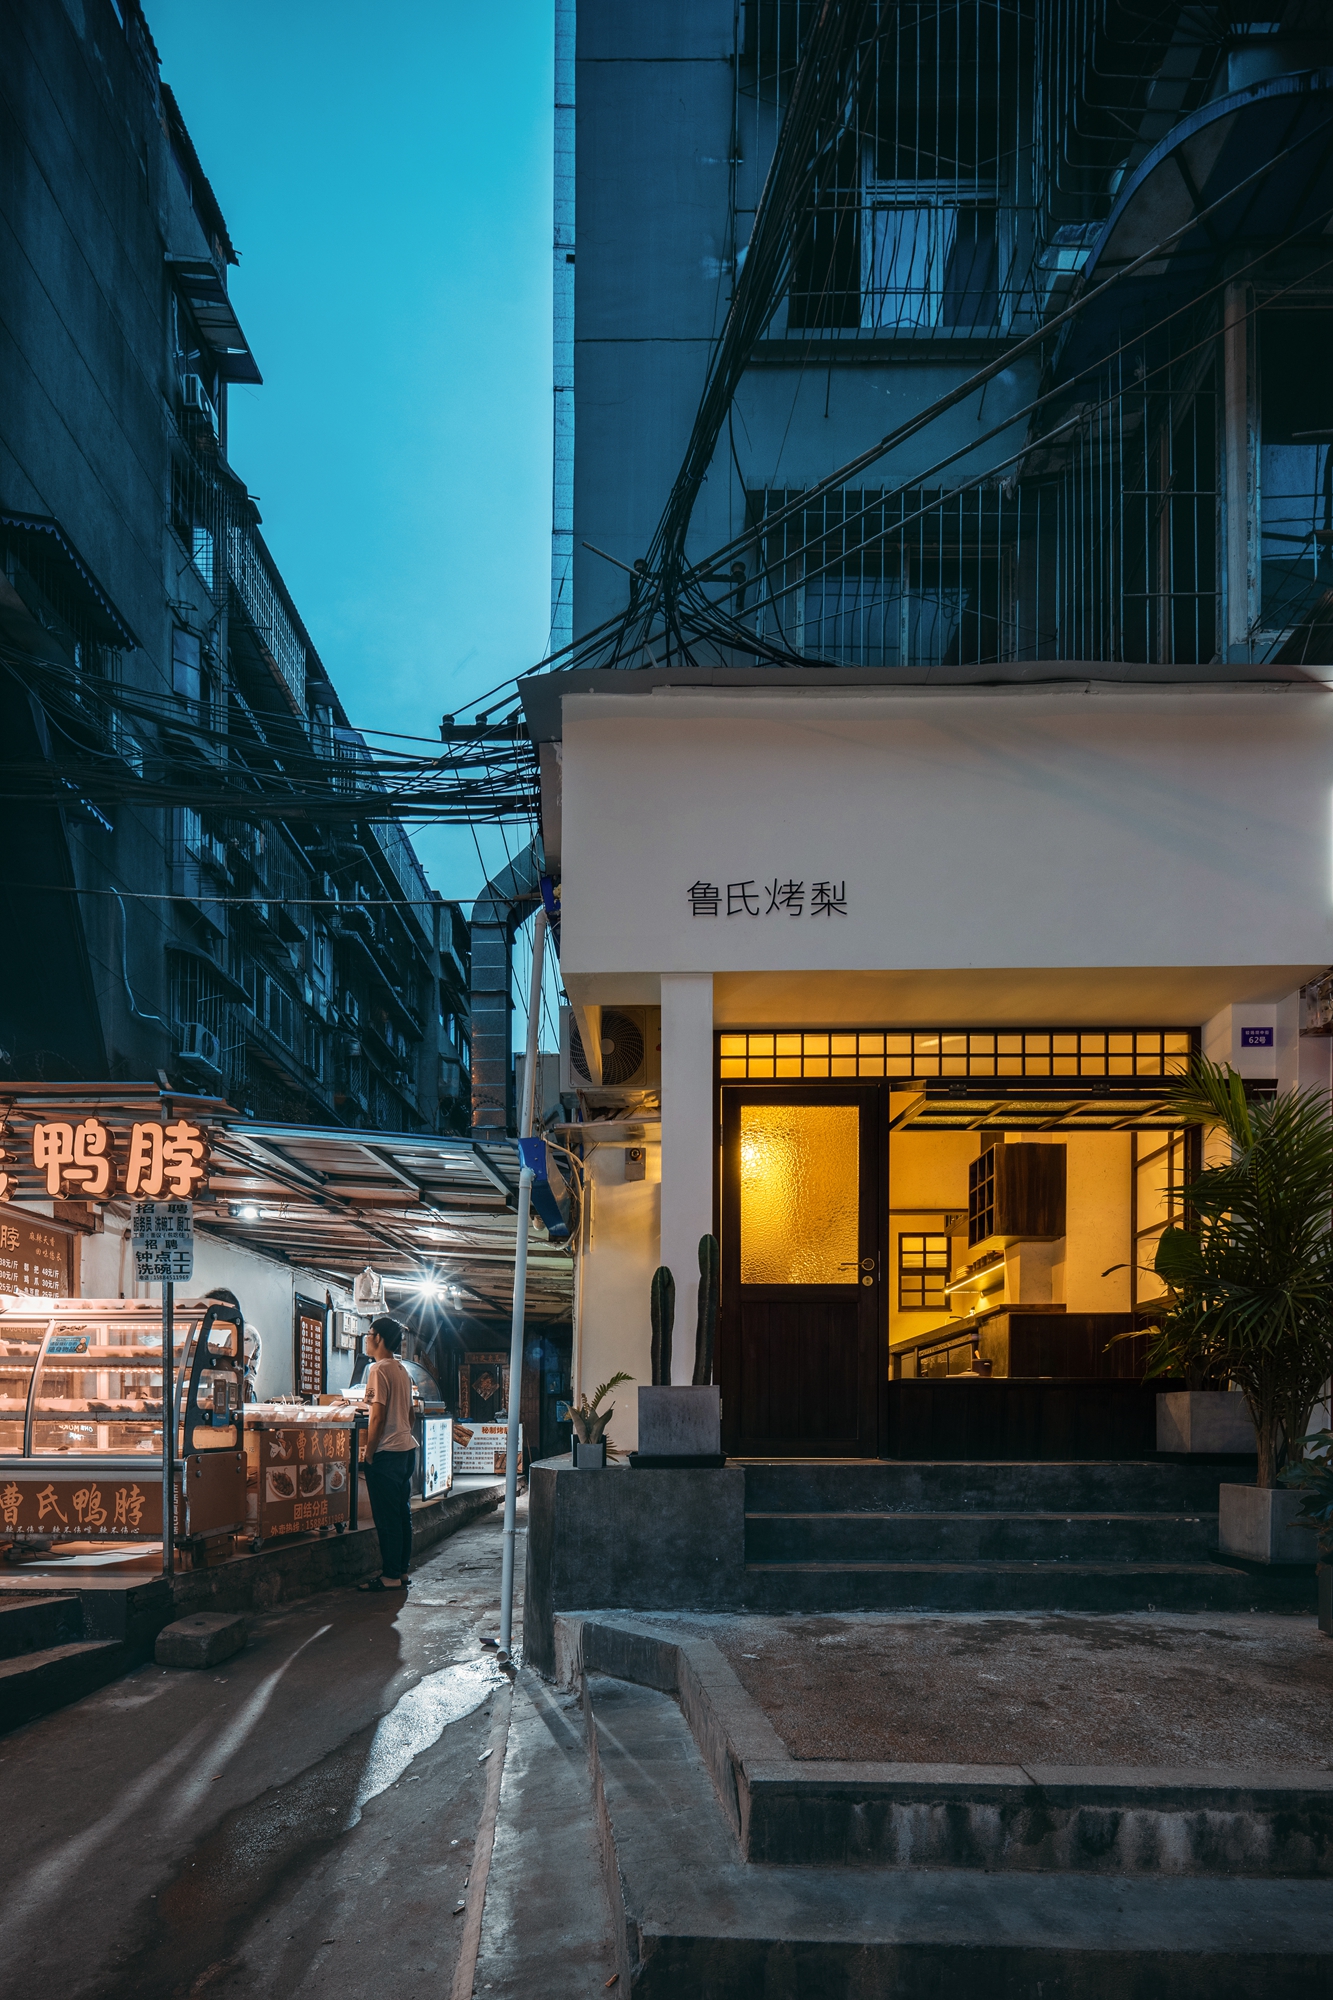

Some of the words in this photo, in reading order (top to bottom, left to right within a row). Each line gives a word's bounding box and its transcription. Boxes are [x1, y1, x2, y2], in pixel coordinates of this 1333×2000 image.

[687, 878, 848, 917] 鲁氏烤梨
[1248, 1036, 1266, 1044] 62号
[0, 1118, 204, 1196] 鸭脖
[133, 1216, 152, 1232] 服务员
[155, 1216, 174, 1232] 洗碗工
[144, 1239, 178, 1250] 招聘
[135, 1251, 191, 1263] 钟点工
[137, 1263, 191, 1275] 洗碗工
[296, 1430, 346, 1460] 曹氏鸭脖
[0, 1481, 146, 1526] 曹氏鸭脖
[293, 1500, 329, 1520] 团结分店
